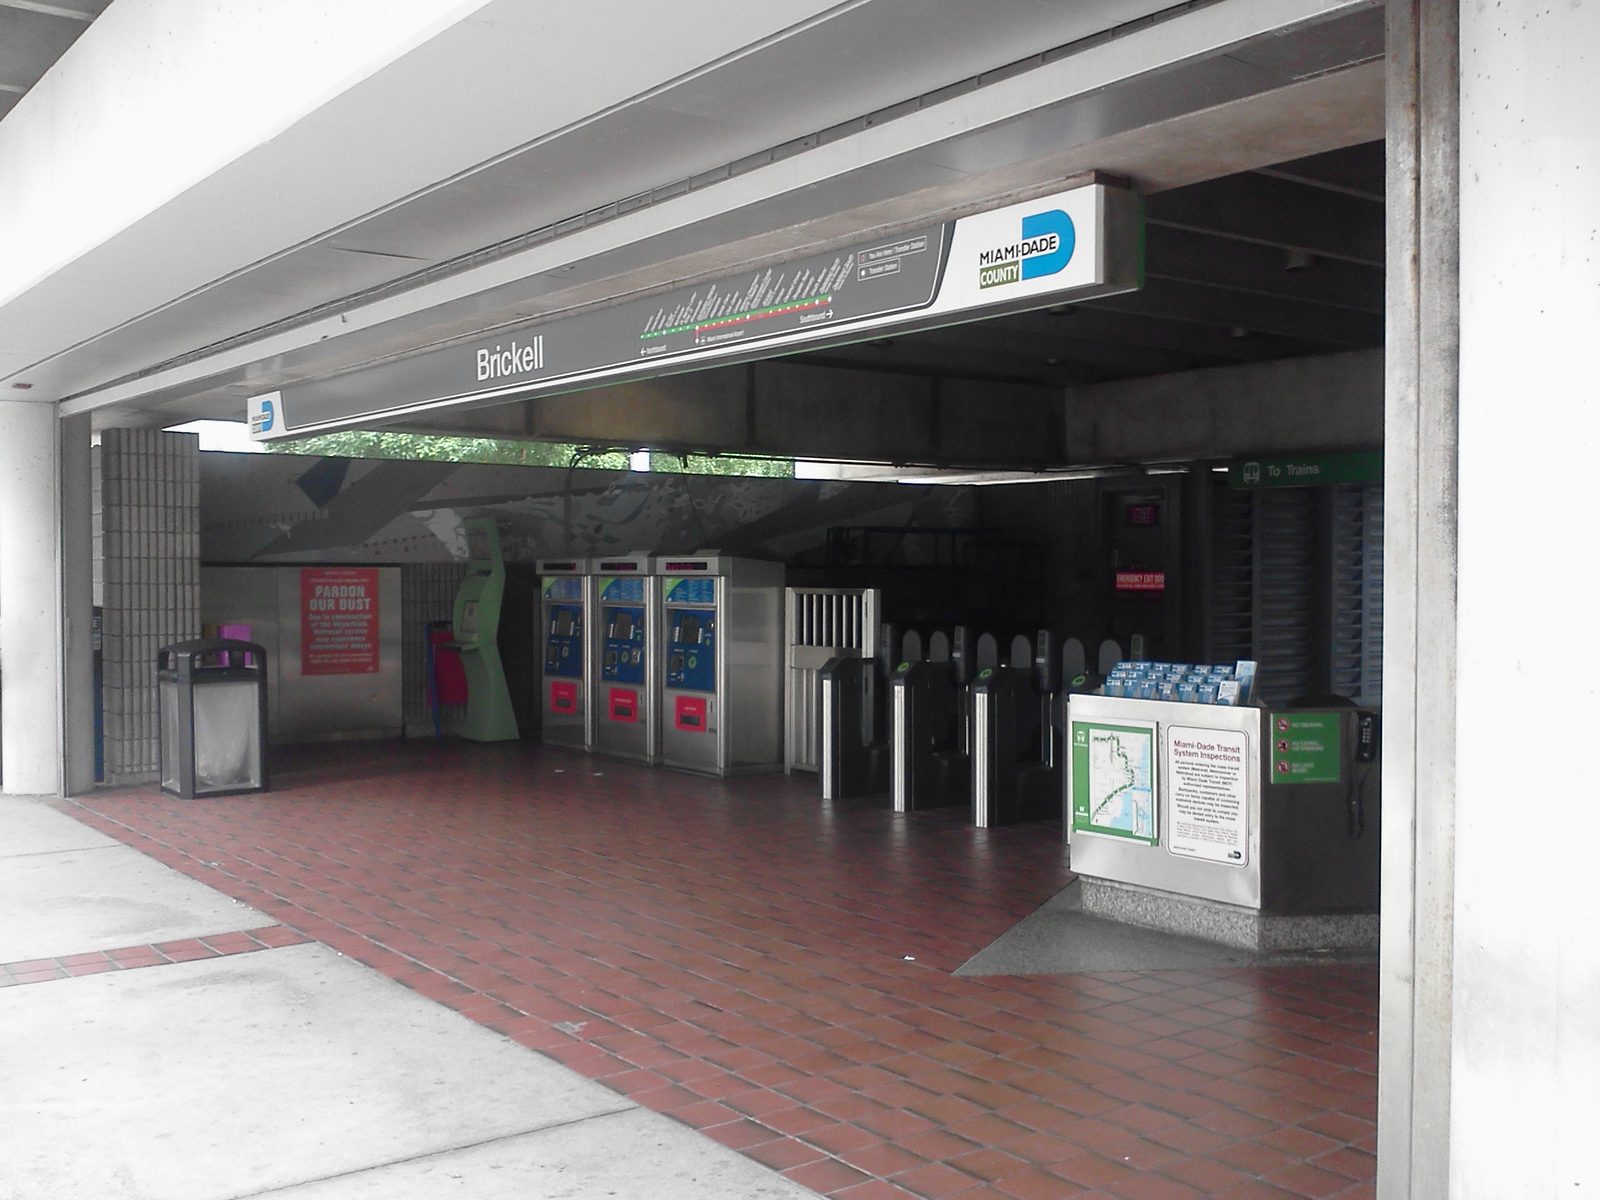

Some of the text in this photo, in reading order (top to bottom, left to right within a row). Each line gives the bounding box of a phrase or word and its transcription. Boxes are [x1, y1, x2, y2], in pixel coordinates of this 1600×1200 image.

[980, 236, 1056, 265] MIAMI-DADE
[981, 265, 1018, 285] COUNTY
[477, 336, 543, 380] Brickell
[1268, 464, 1320, 476] To Trains
[315, 585, 365, 597] PARDON
[310, 598, 371, 610] OUR DUST
[1174, 740, 1240, 753] Miami-Dade Transit
[1174, 749, 1240, 762] System Inspections
